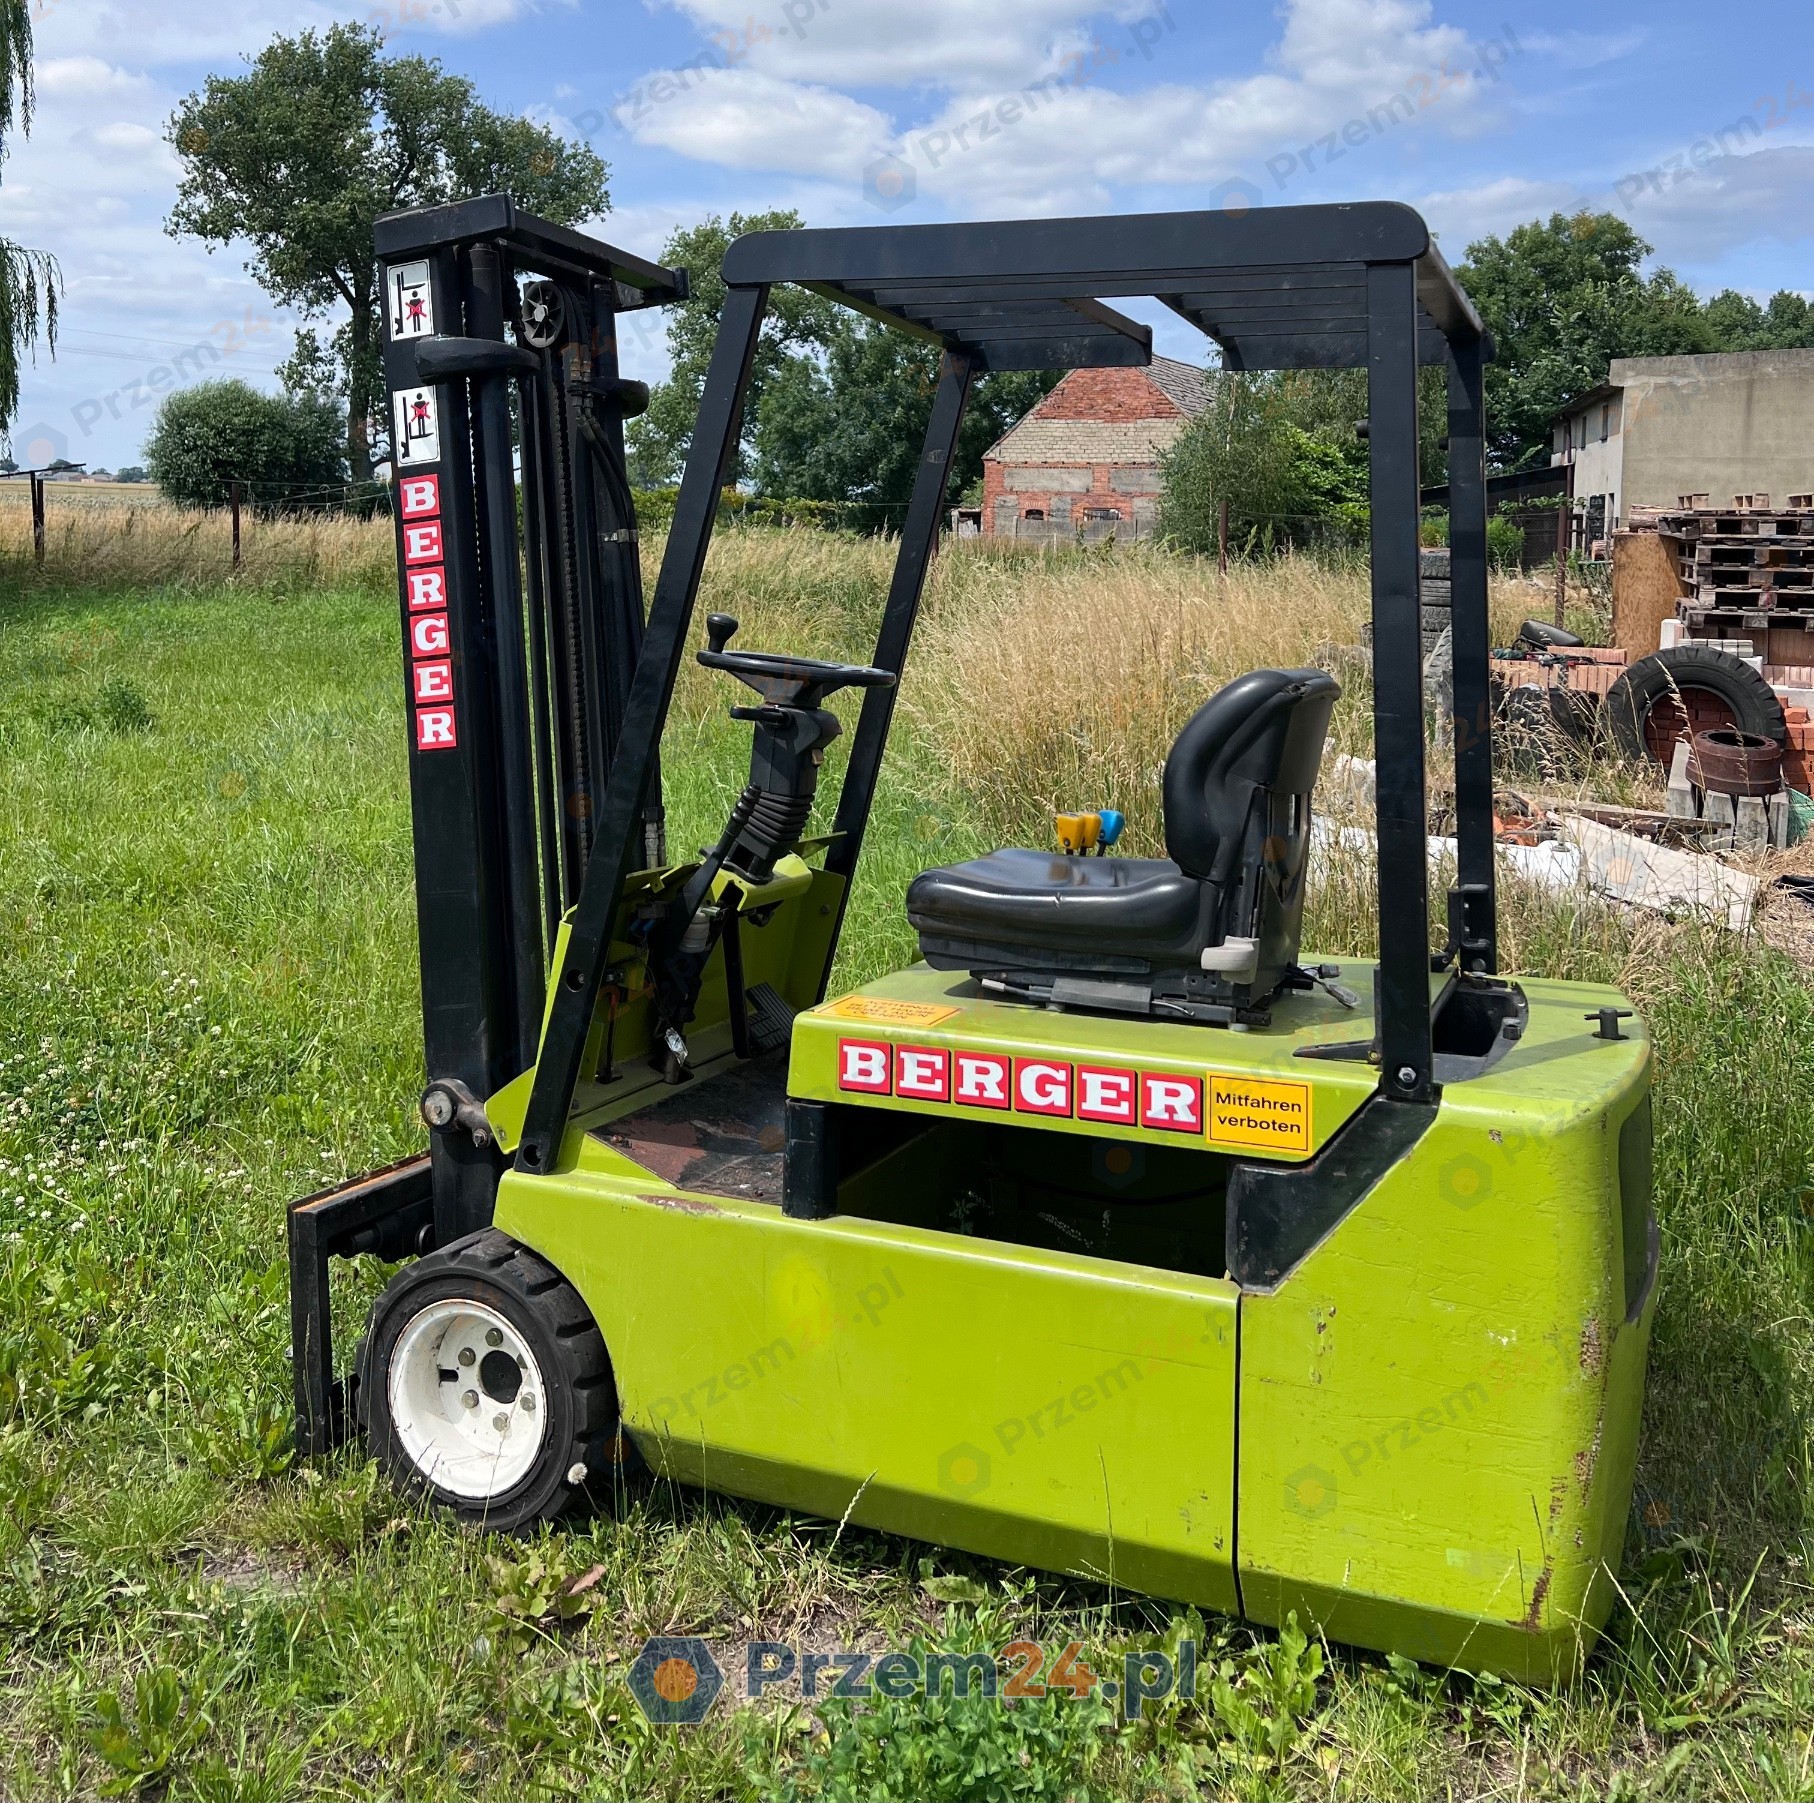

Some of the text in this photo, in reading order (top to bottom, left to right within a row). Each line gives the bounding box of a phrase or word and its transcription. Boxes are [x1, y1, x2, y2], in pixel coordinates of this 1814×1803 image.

[403, 480, 454, 744] BERGER
[842, 1044, 1197, 1123] BERGER
[1215, 1091, 1302, 1113] Mitfahren
[1217, 1115, 1301, 1134] verboten
